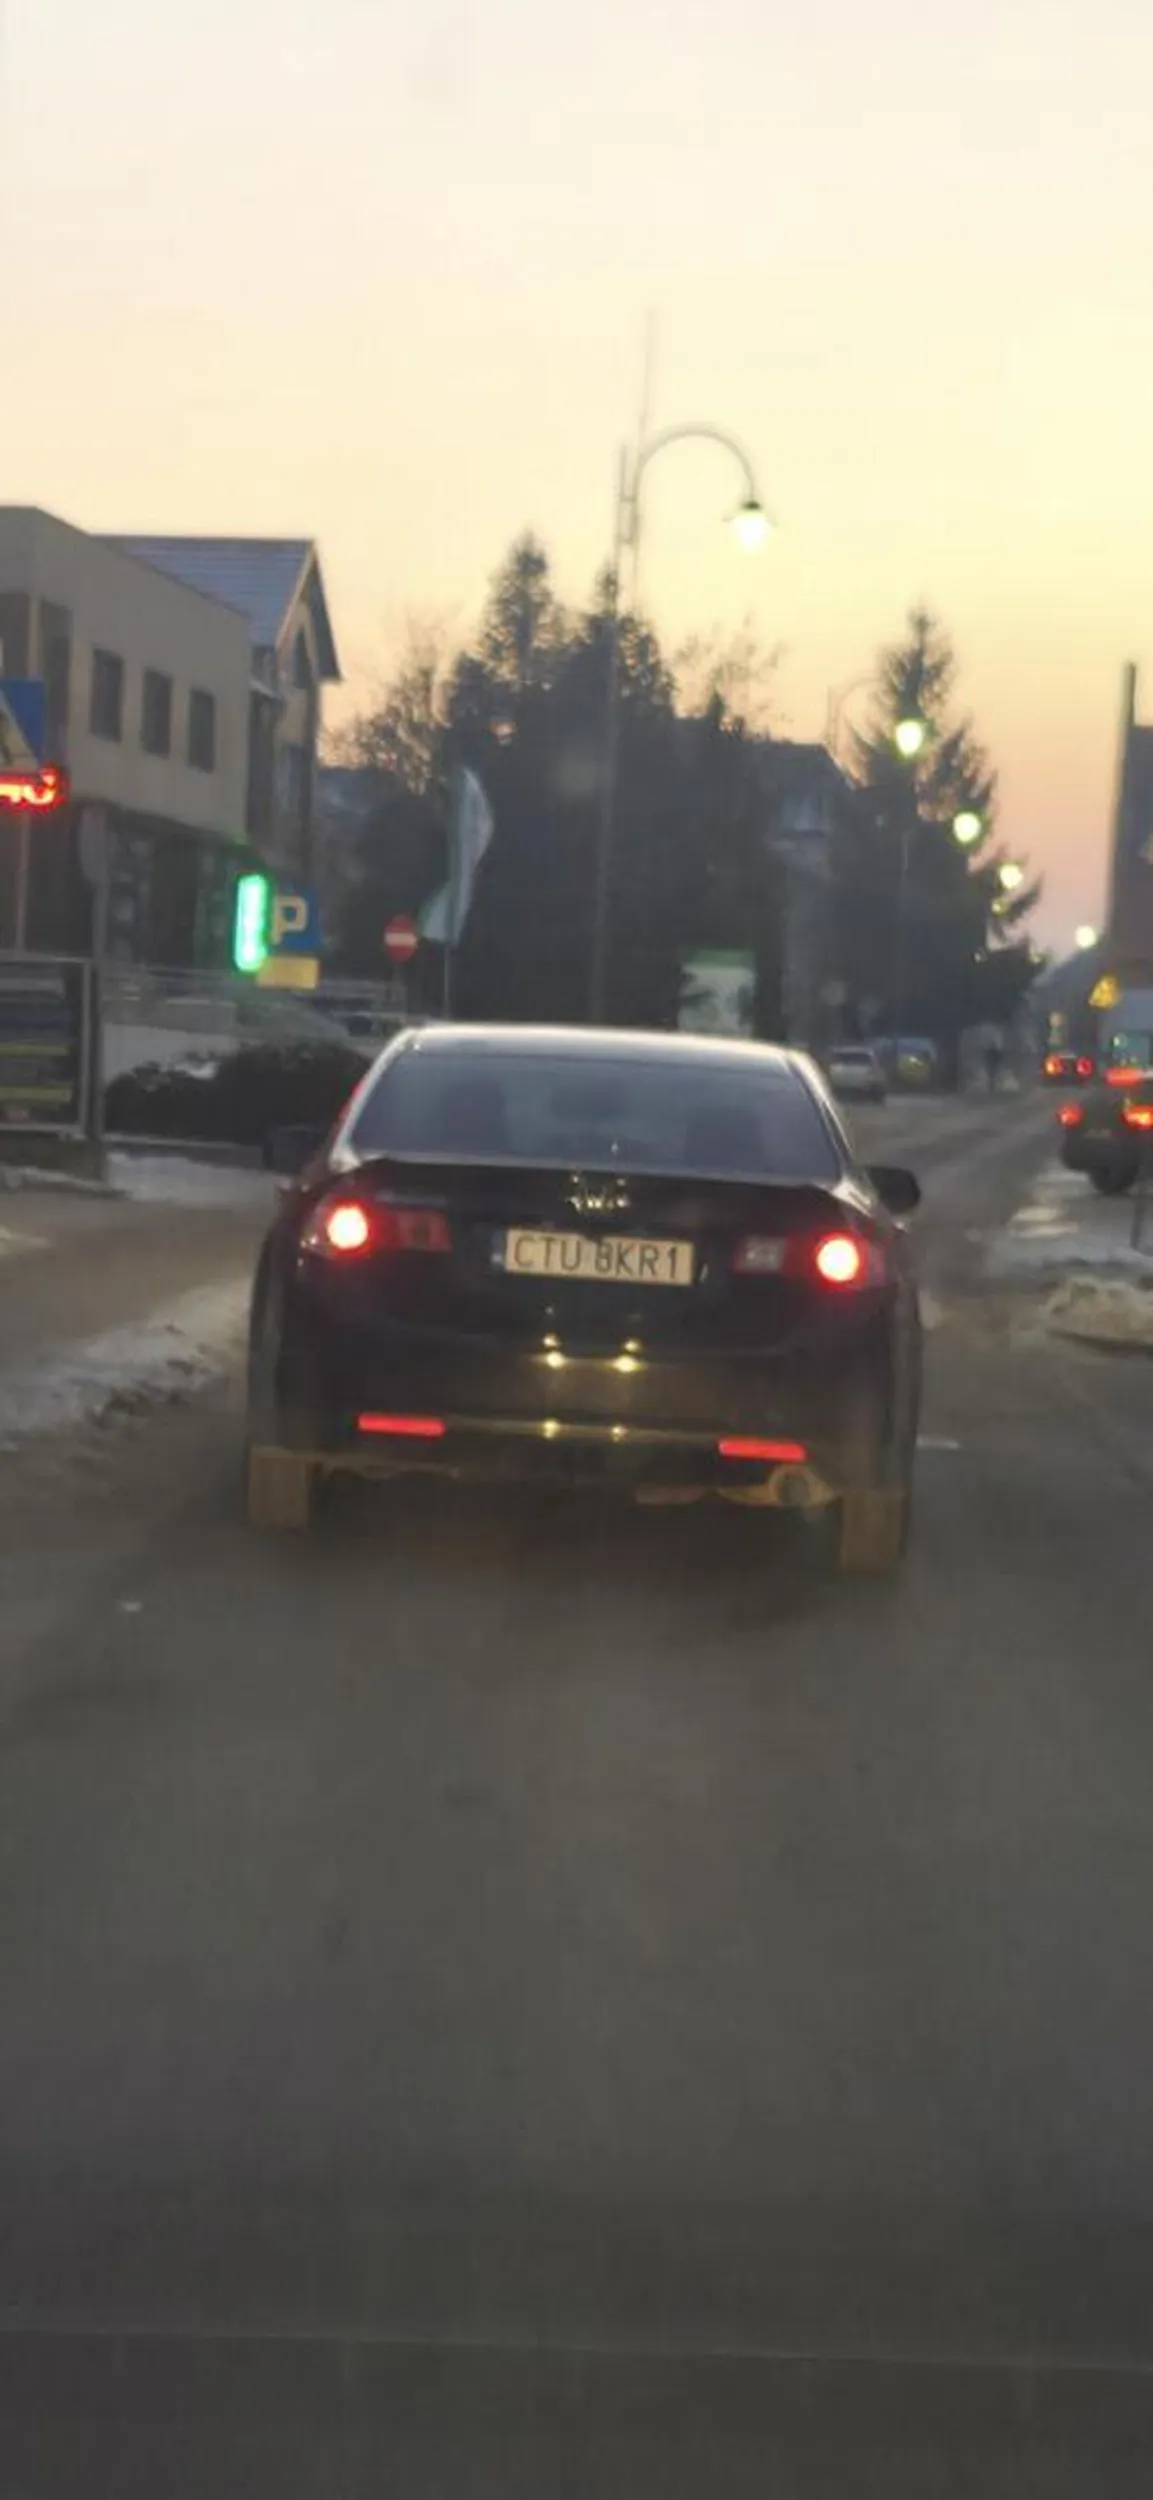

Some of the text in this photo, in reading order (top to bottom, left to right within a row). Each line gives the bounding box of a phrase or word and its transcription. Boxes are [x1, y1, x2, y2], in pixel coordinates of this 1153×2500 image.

[272, 896, 308, 945] P
[514, 1235, 677, 1280] CTU 8KR1
